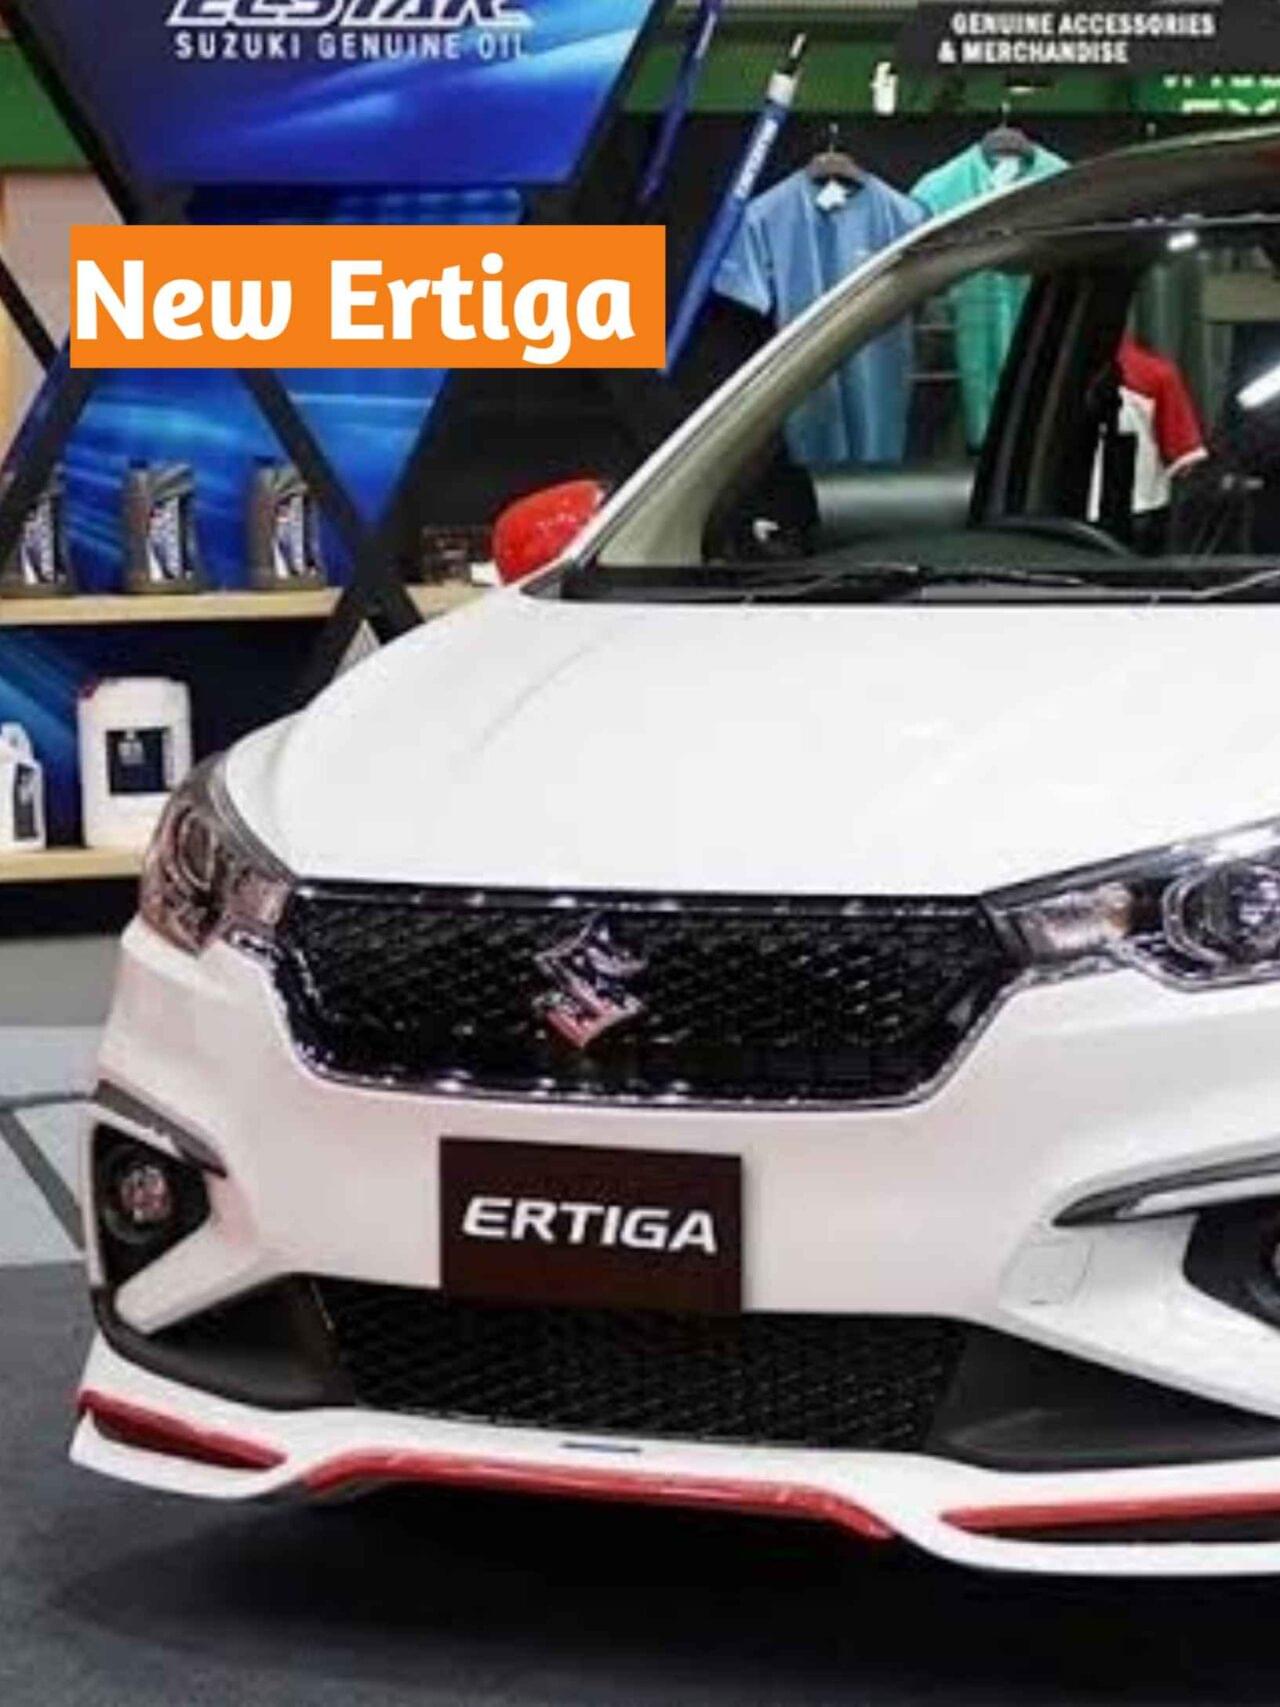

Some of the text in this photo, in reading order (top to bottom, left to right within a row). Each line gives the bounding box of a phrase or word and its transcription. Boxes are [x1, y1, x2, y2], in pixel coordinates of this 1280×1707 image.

[951, 12, 1216, 36] GENUINE ACCESSORIES
[174, 32, 530, 60] SUZUKI GENUINE OIL
[937, 40, 1129, 63] & MERCHANDISE
[462, 1197, 717, 1253] ERTIGA
